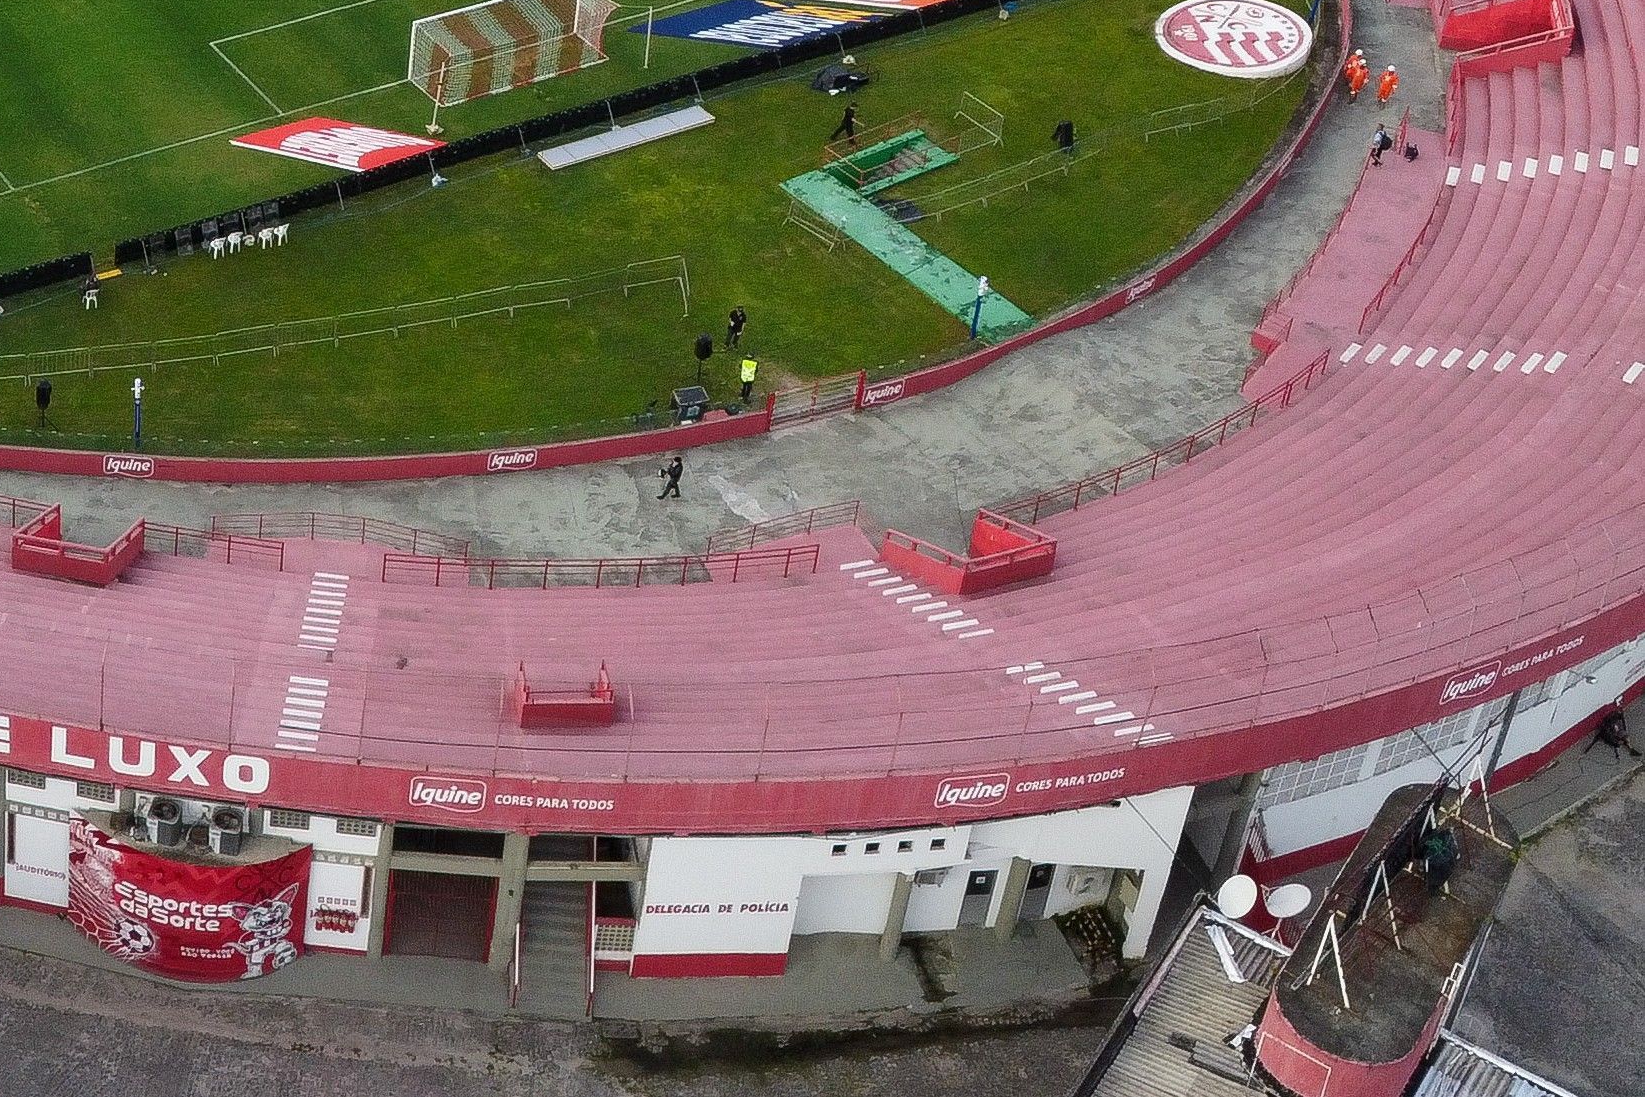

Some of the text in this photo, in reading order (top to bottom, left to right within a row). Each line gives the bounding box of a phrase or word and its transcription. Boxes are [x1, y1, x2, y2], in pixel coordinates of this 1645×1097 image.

[864, 382, 904, 404] Iquine
[106, 456, 152, 476] Iquine
[490, 450, 536, 470] Iquine
[1444, 635, 1585, 702] Iquine CORES PARA TODOS
[51, 727, 270, 794] LUXO
[413, 782, 614, 812] Iquine CORES PARA TODOS
[939, 767, 1125, 805] Iquine CORES PARA TODOS
[115, 881, 234, 918] Esportes
[646, 900, 789, 914] DELEGACIA DE POLÍCIA
[120, 900, 221, 933] da Sorte
